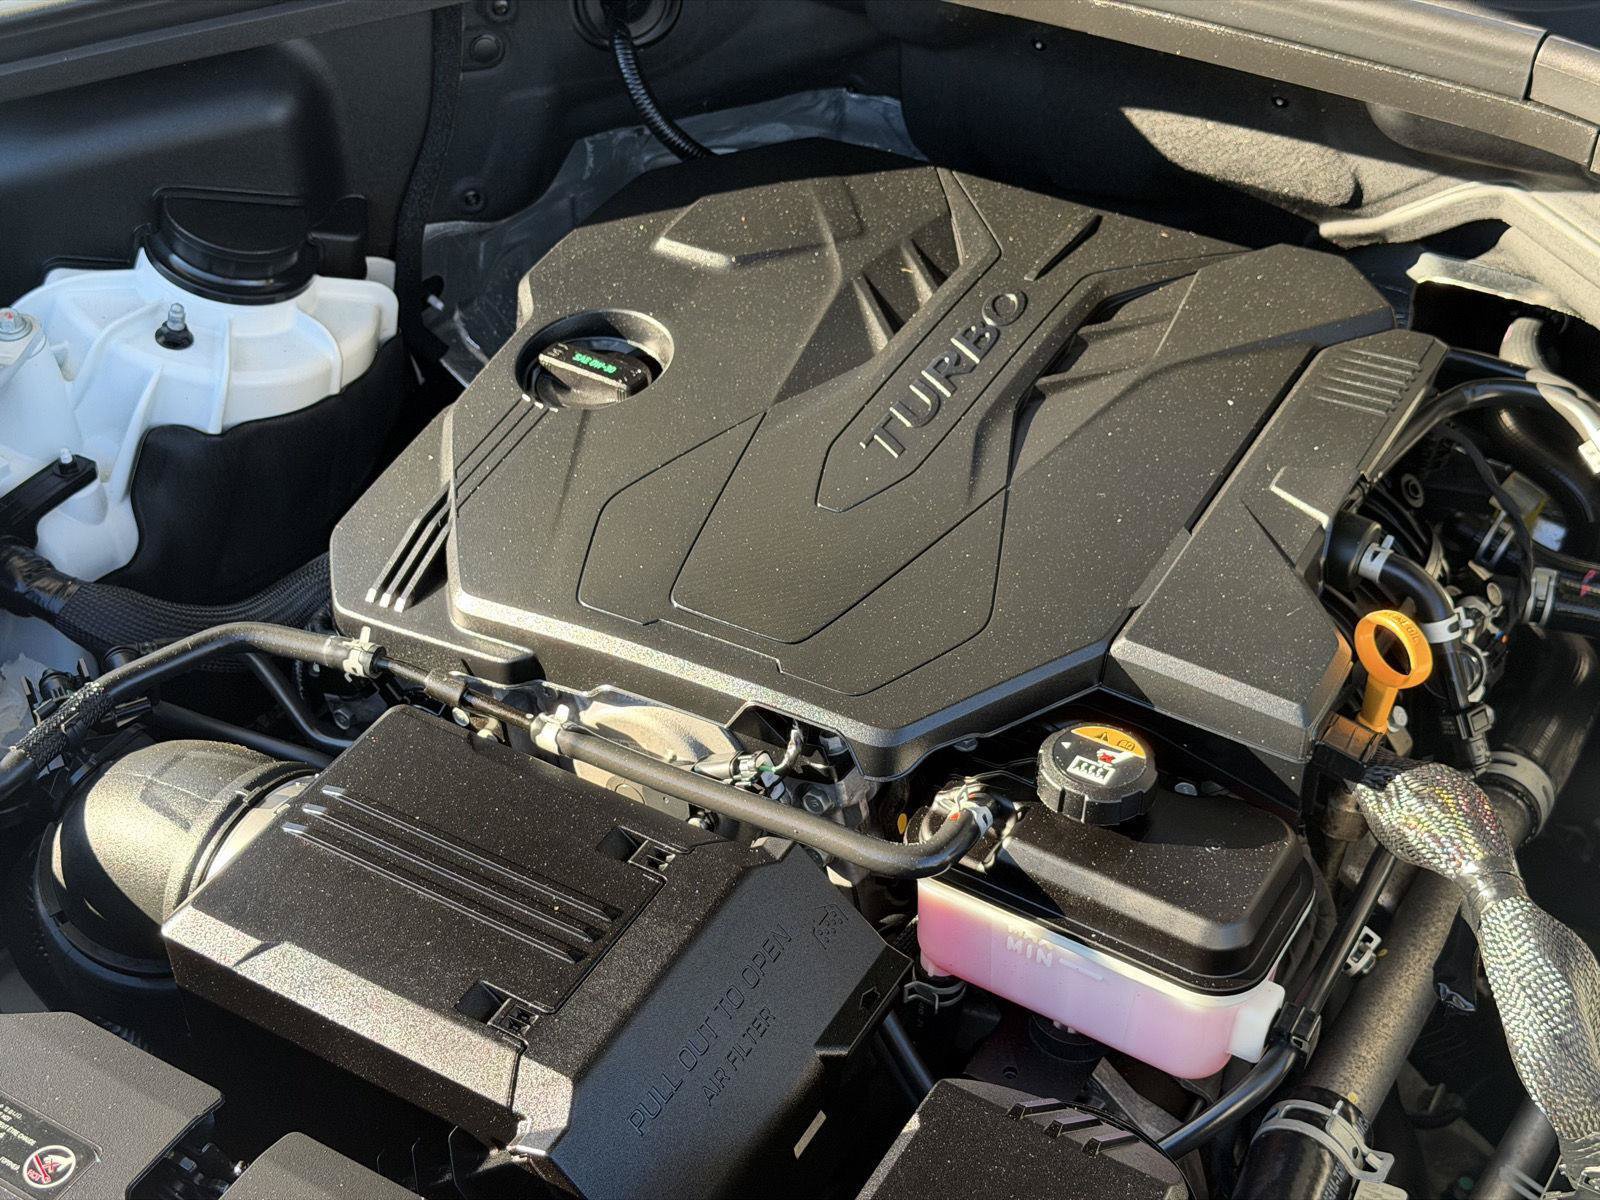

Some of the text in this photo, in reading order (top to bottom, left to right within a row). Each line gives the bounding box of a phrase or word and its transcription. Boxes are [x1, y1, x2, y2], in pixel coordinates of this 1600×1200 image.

[859, 290, 1028, 459] TURBO
[1006, 935, 1053, 968] MIN
[626, 922, 793, 1137] PULL OUT TO OPEN
[701, 1006, 776, 1107] AIR FILTER
